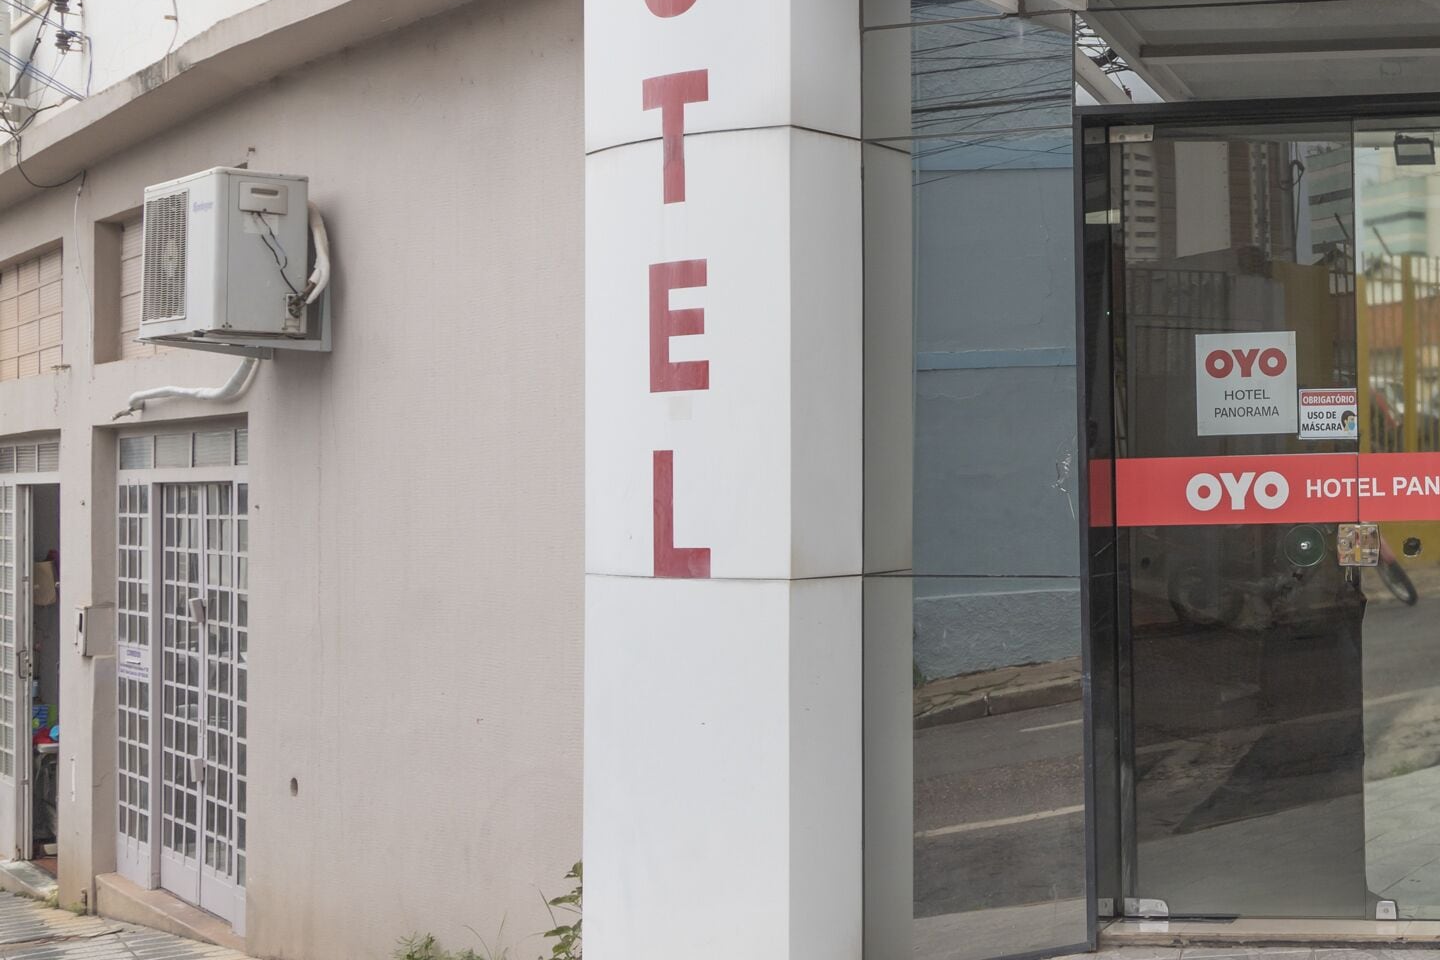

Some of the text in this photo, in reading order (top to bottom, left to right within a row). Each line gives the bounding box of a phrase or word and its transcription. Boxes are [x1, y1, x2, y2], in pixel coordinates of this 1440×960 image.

[1205, 348, 1287, 379] OYO
[1224, 389, 1271, 401] HOTEL
[1302, 394, 1355, 405] OBRIGATÓRIO
[1214, 405, 1280, 418] PANORAMA
[1307, 411, 1337, 420] USO DE
[1301, 421, 1343, 431] MÁSCARA
[1185, 471, 1290, 511] OYO
[1306, 477, 1386, 498] HOTEL
